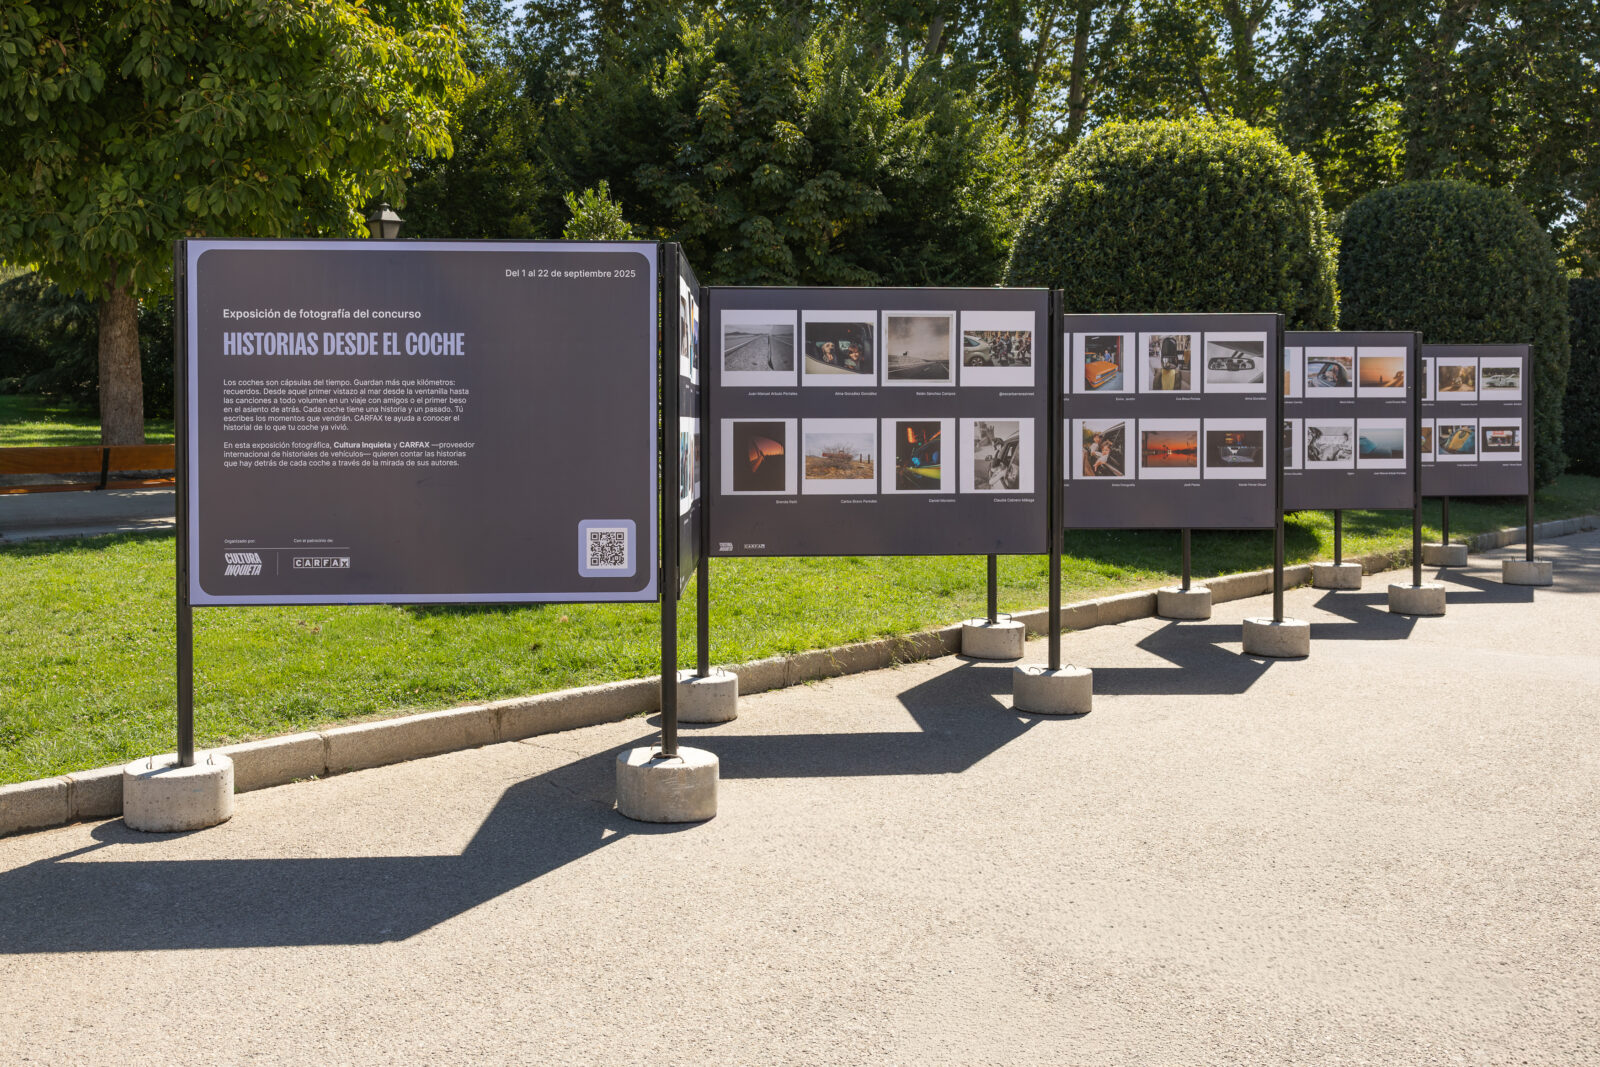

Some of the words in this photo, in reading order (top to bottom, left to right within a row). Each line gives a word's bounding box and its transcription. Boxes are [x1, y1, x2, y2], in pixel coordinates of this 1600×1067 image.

[505, 269, 520, 277] Del
[528, 269, 536, 277] al
[538, 269, 549, 277] 22
[550, 269, 562, 278] de
[564, 269, 612, 279] septiembre
[614, 269, 636, 278] 2025
[223, 308, 281, 320] Exposición
[283, 309, 297, 318] de
[299, 308, 351, 320] fotografía
[352, 309, 370, 318] del
[371, 311, 422, 319] concurso
[223, 332, 319, 356] HISTORIAS
[323, 332, 379, 356] DESDE
[382, 332, 402, 356] EL
[405, 332, 465, 356] COCHE
[280, 378, 312, 387] cápsulas
[325, 378, 352, 387] tiempo.
[287, 387, 307, 396] aquel
[308, 388, 331, 396] primer
[350, 397, 367, 405] viaje
[383, 397, 409, 405] amigos
[424, 405, 453, 414] pasado.
[393, 414, 415, 423] ayuda
[252, 441, 290, 450] exposición
[291, 441, 332, 450] fotográfica,
[361, 441, 392, 450] Inquieta
[372, 450, 399, 458] quieren
[239, 460, 253, 468] hay
[224, 552, 262, 564] CULTURA
[294, 558, 349, 568] CARFAX
[224, 564, 262, 576] INQUIETA
